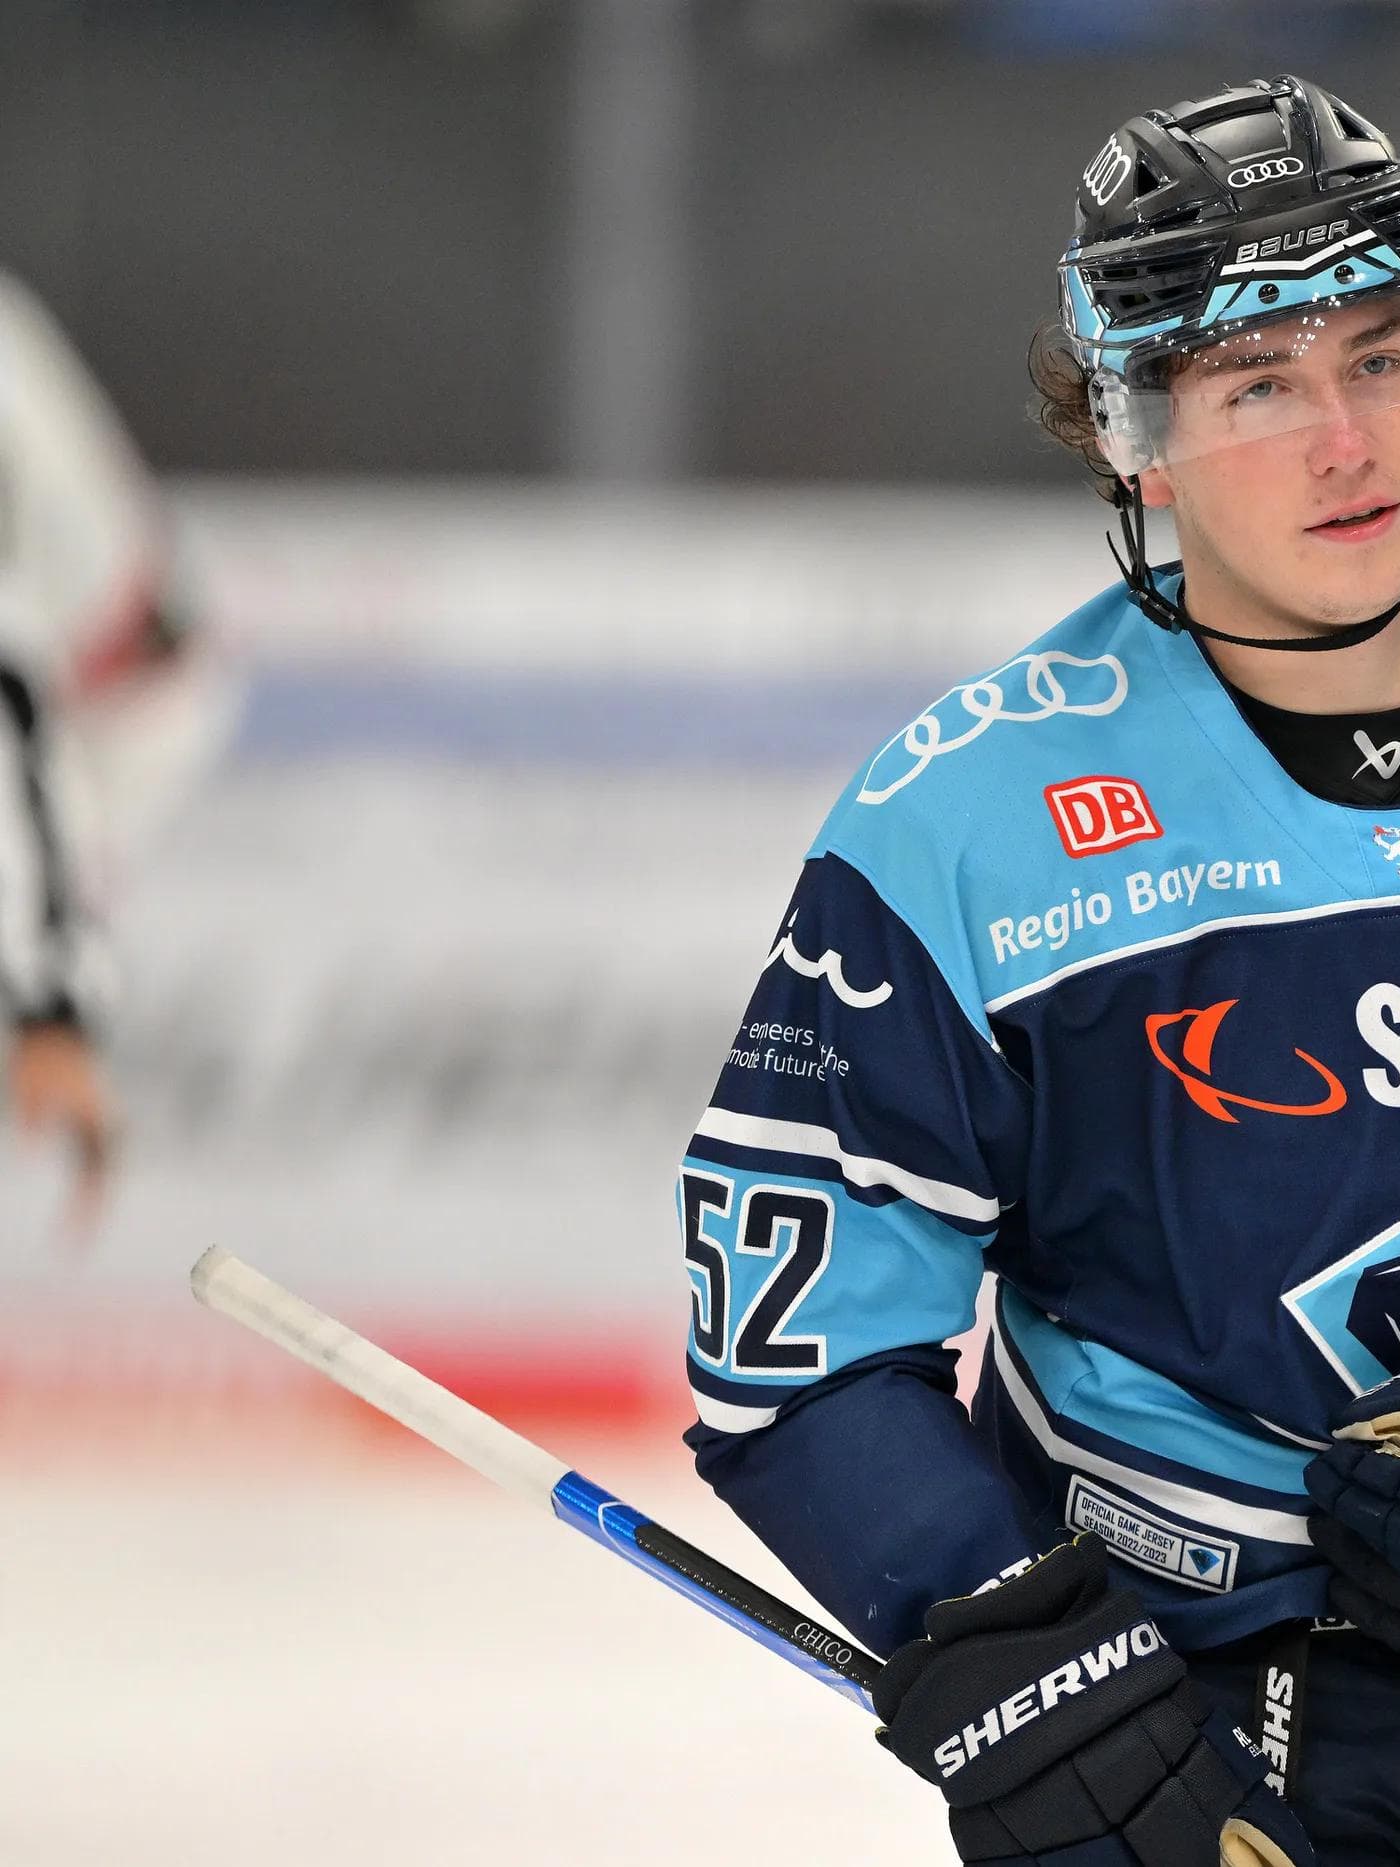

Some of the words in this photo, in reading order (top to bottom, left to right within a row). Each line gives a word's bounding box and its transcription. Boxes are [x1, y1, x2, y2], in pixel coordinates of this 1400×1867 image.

[1056, 784, 1148, 846] DB
[988, 888, 1112, 965] Regio
[1125, 859, 1281, 915] Bayern
[764, 1048, 826, 1081] future
[679, 1164, 835, 1376] 52
[1081, 1497, 1115, 1524] OFFICIAL
[1117, 1516, 1140, 1536] GAME
[1141, 1528, 1175, 1551] JERSEY
[1083, 1515, 1116, 1541] SEASON
[1116, 1532, 1167, 1564] 2022/2023
[793, 1622, 853, 1665] CHICO
